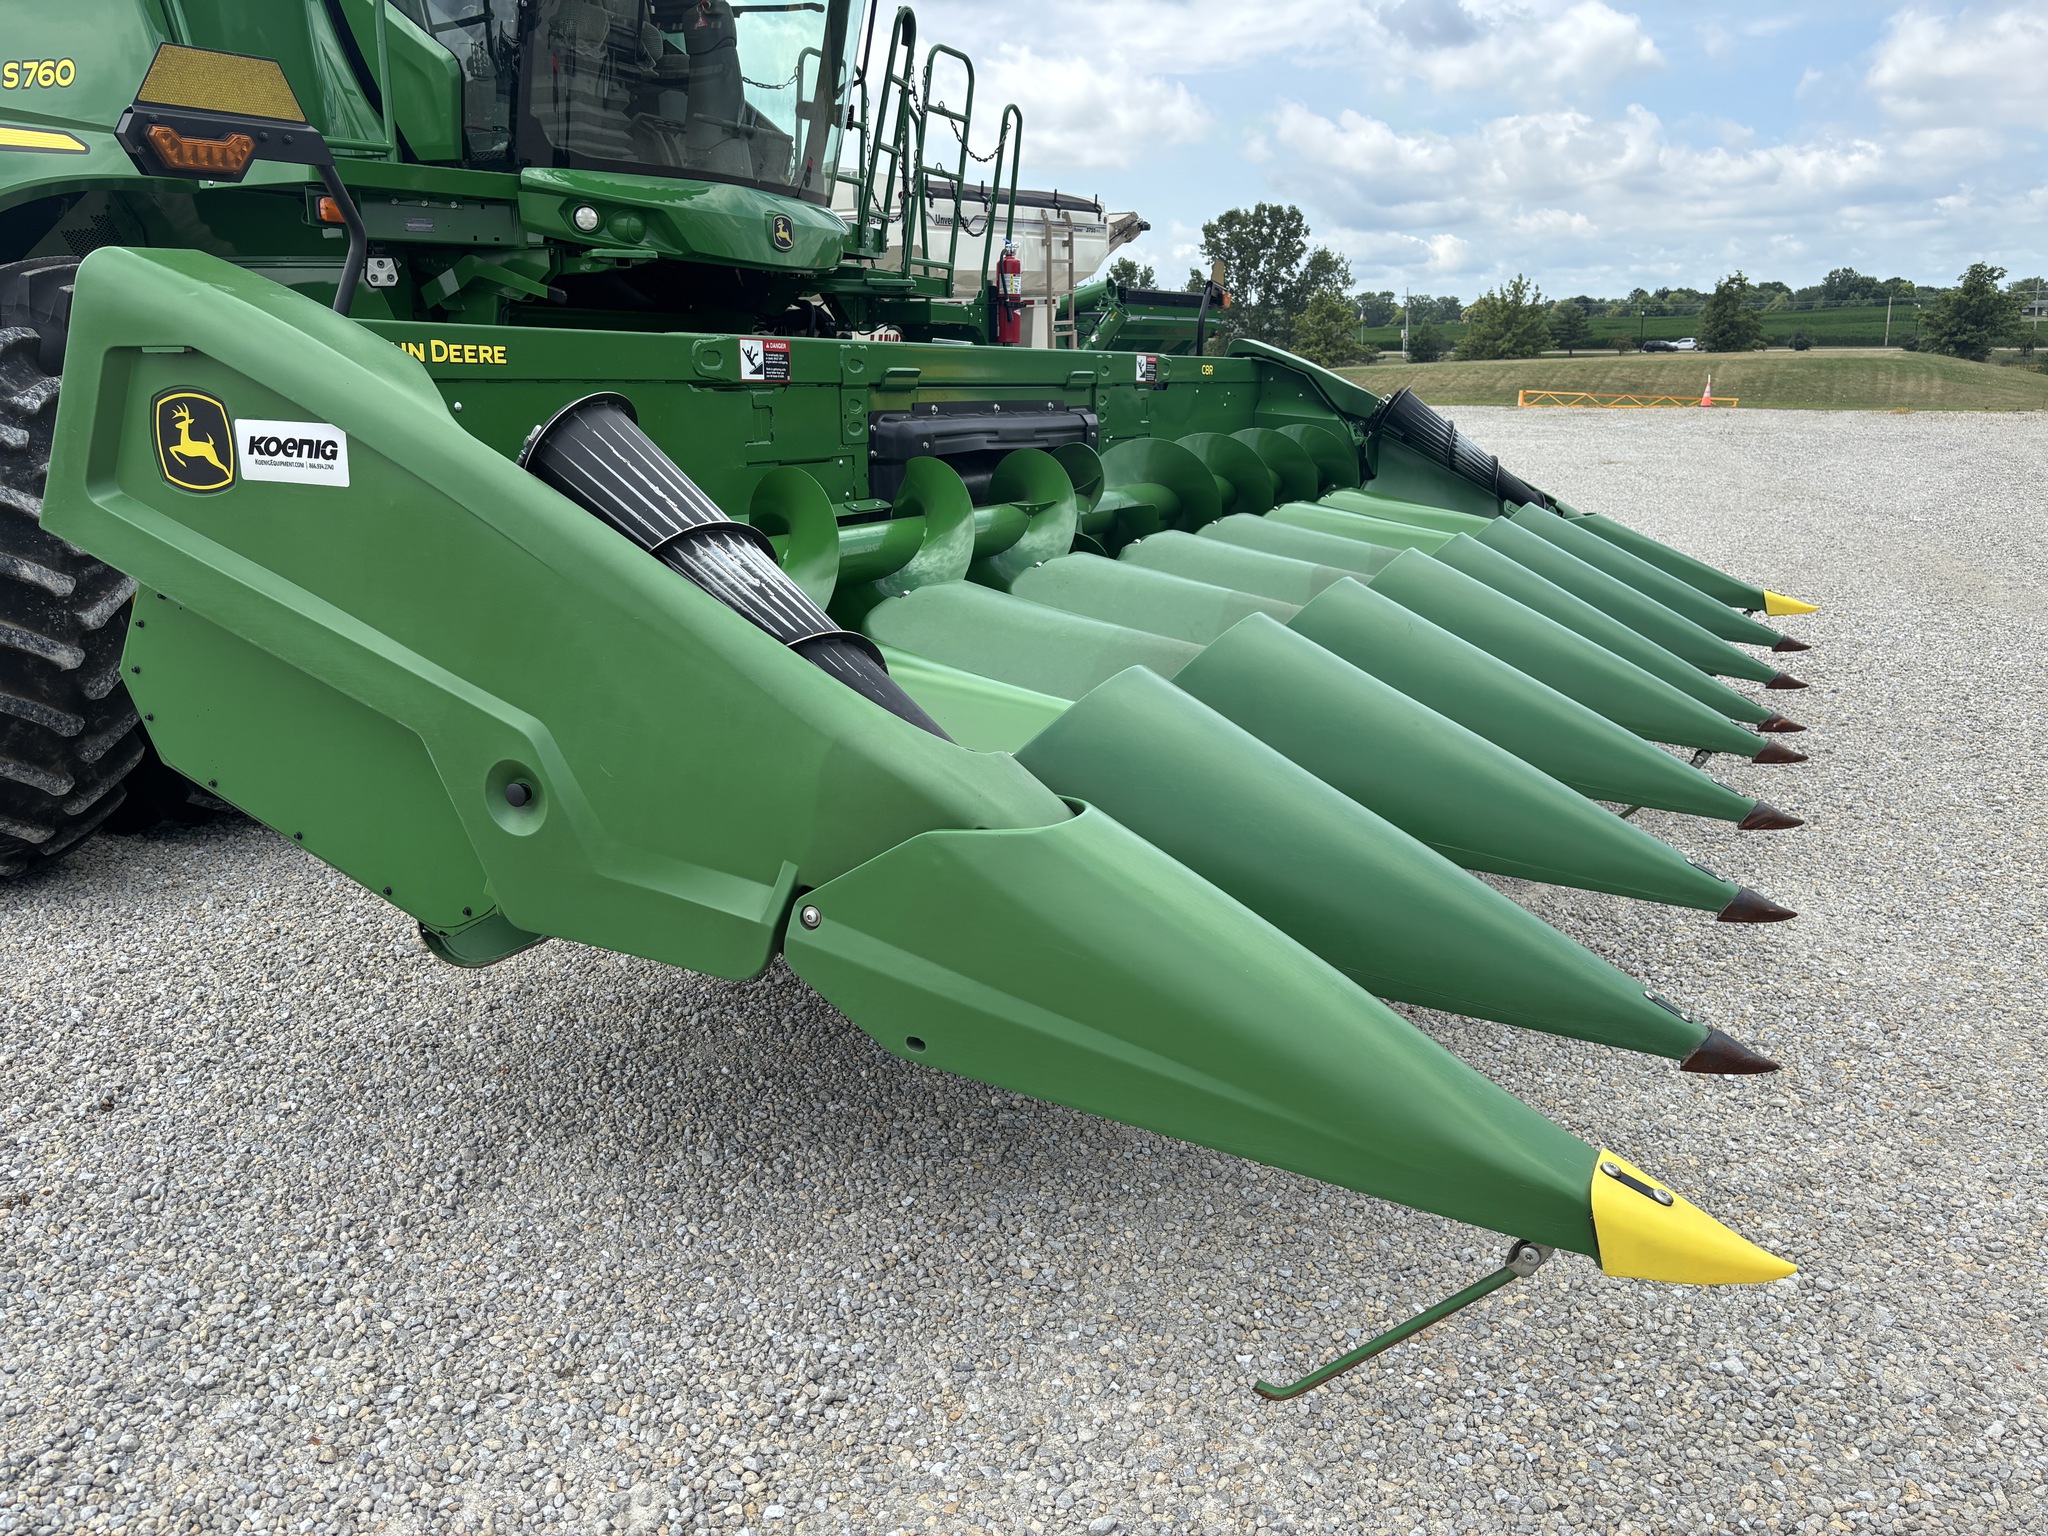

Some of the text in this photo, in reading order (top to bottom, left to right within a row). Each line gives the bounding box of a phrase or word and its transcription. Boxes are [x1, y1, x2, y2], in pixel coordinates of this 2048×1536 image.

[2, 57, 76, 90] S760
[430, 339, 507, 364] DEERE
[770, 342, 787, 350] DANGER
